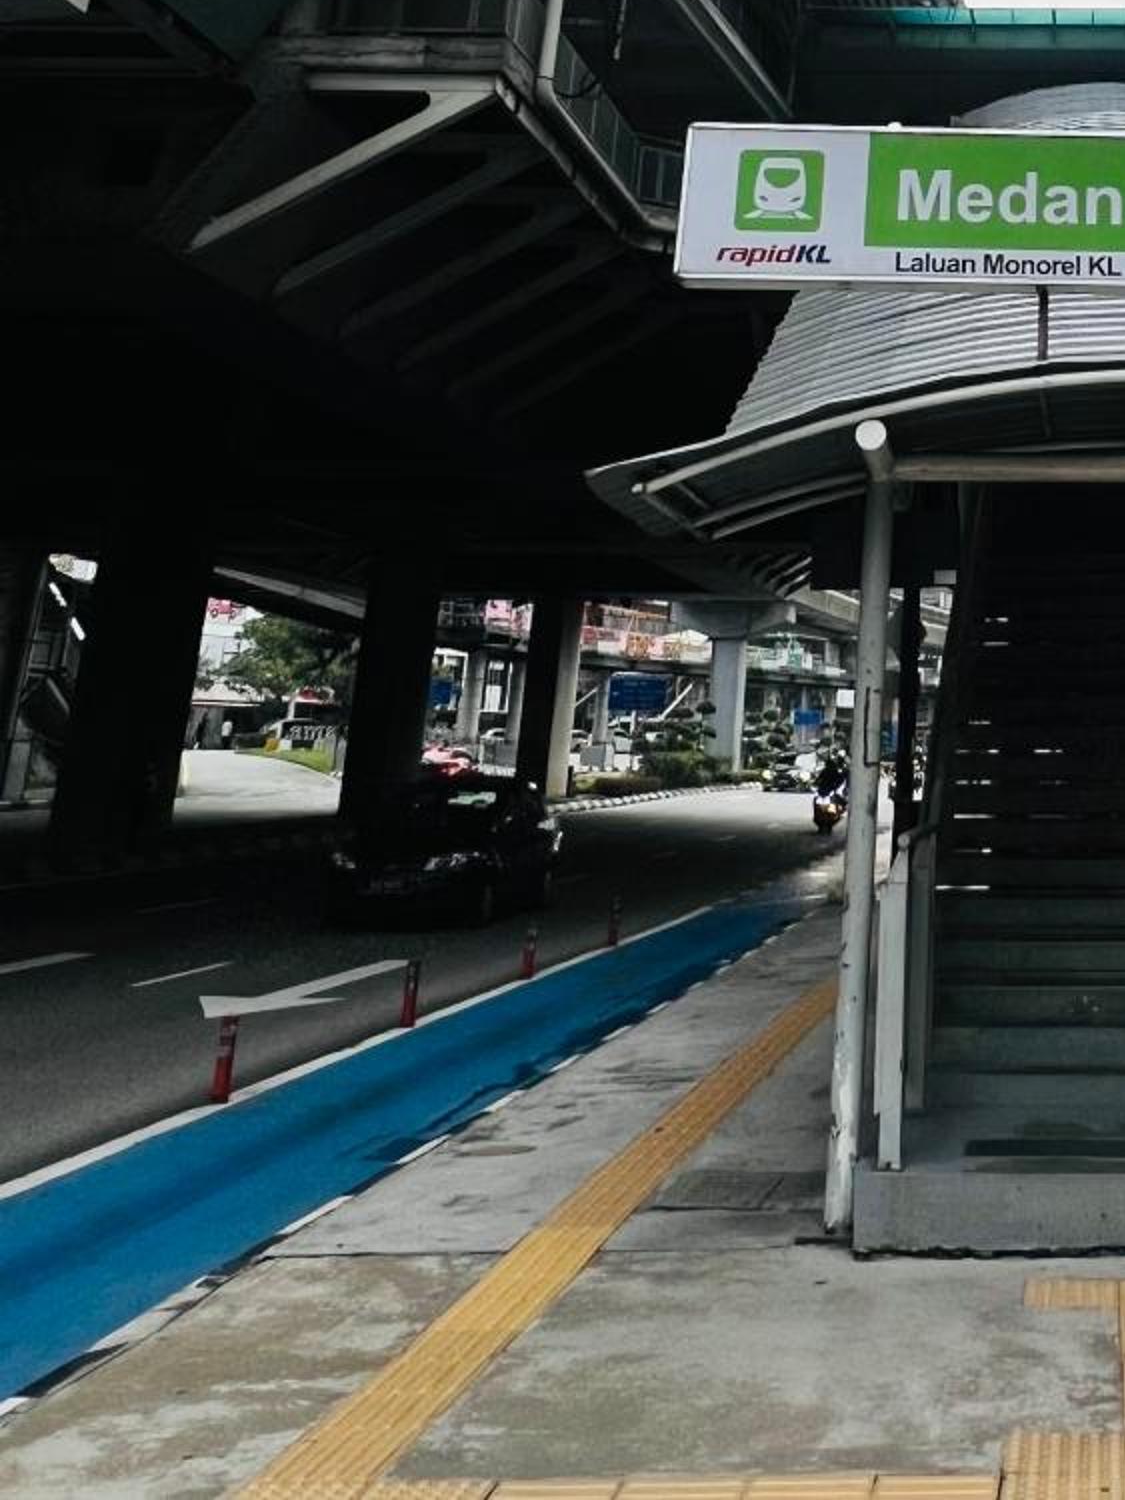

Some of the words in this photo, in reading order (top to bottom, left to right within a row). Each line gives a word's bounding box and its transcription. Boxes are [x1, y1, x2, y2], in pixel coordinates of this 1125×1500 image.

[896, 168, 1123, 226] Medan
[716, 244, 832, 267] rapidKL
[895, 252, 976, 274] Laluan
[983, 253, 1081, 277] Monorel
[1089, 256, 1122, 277] KL
